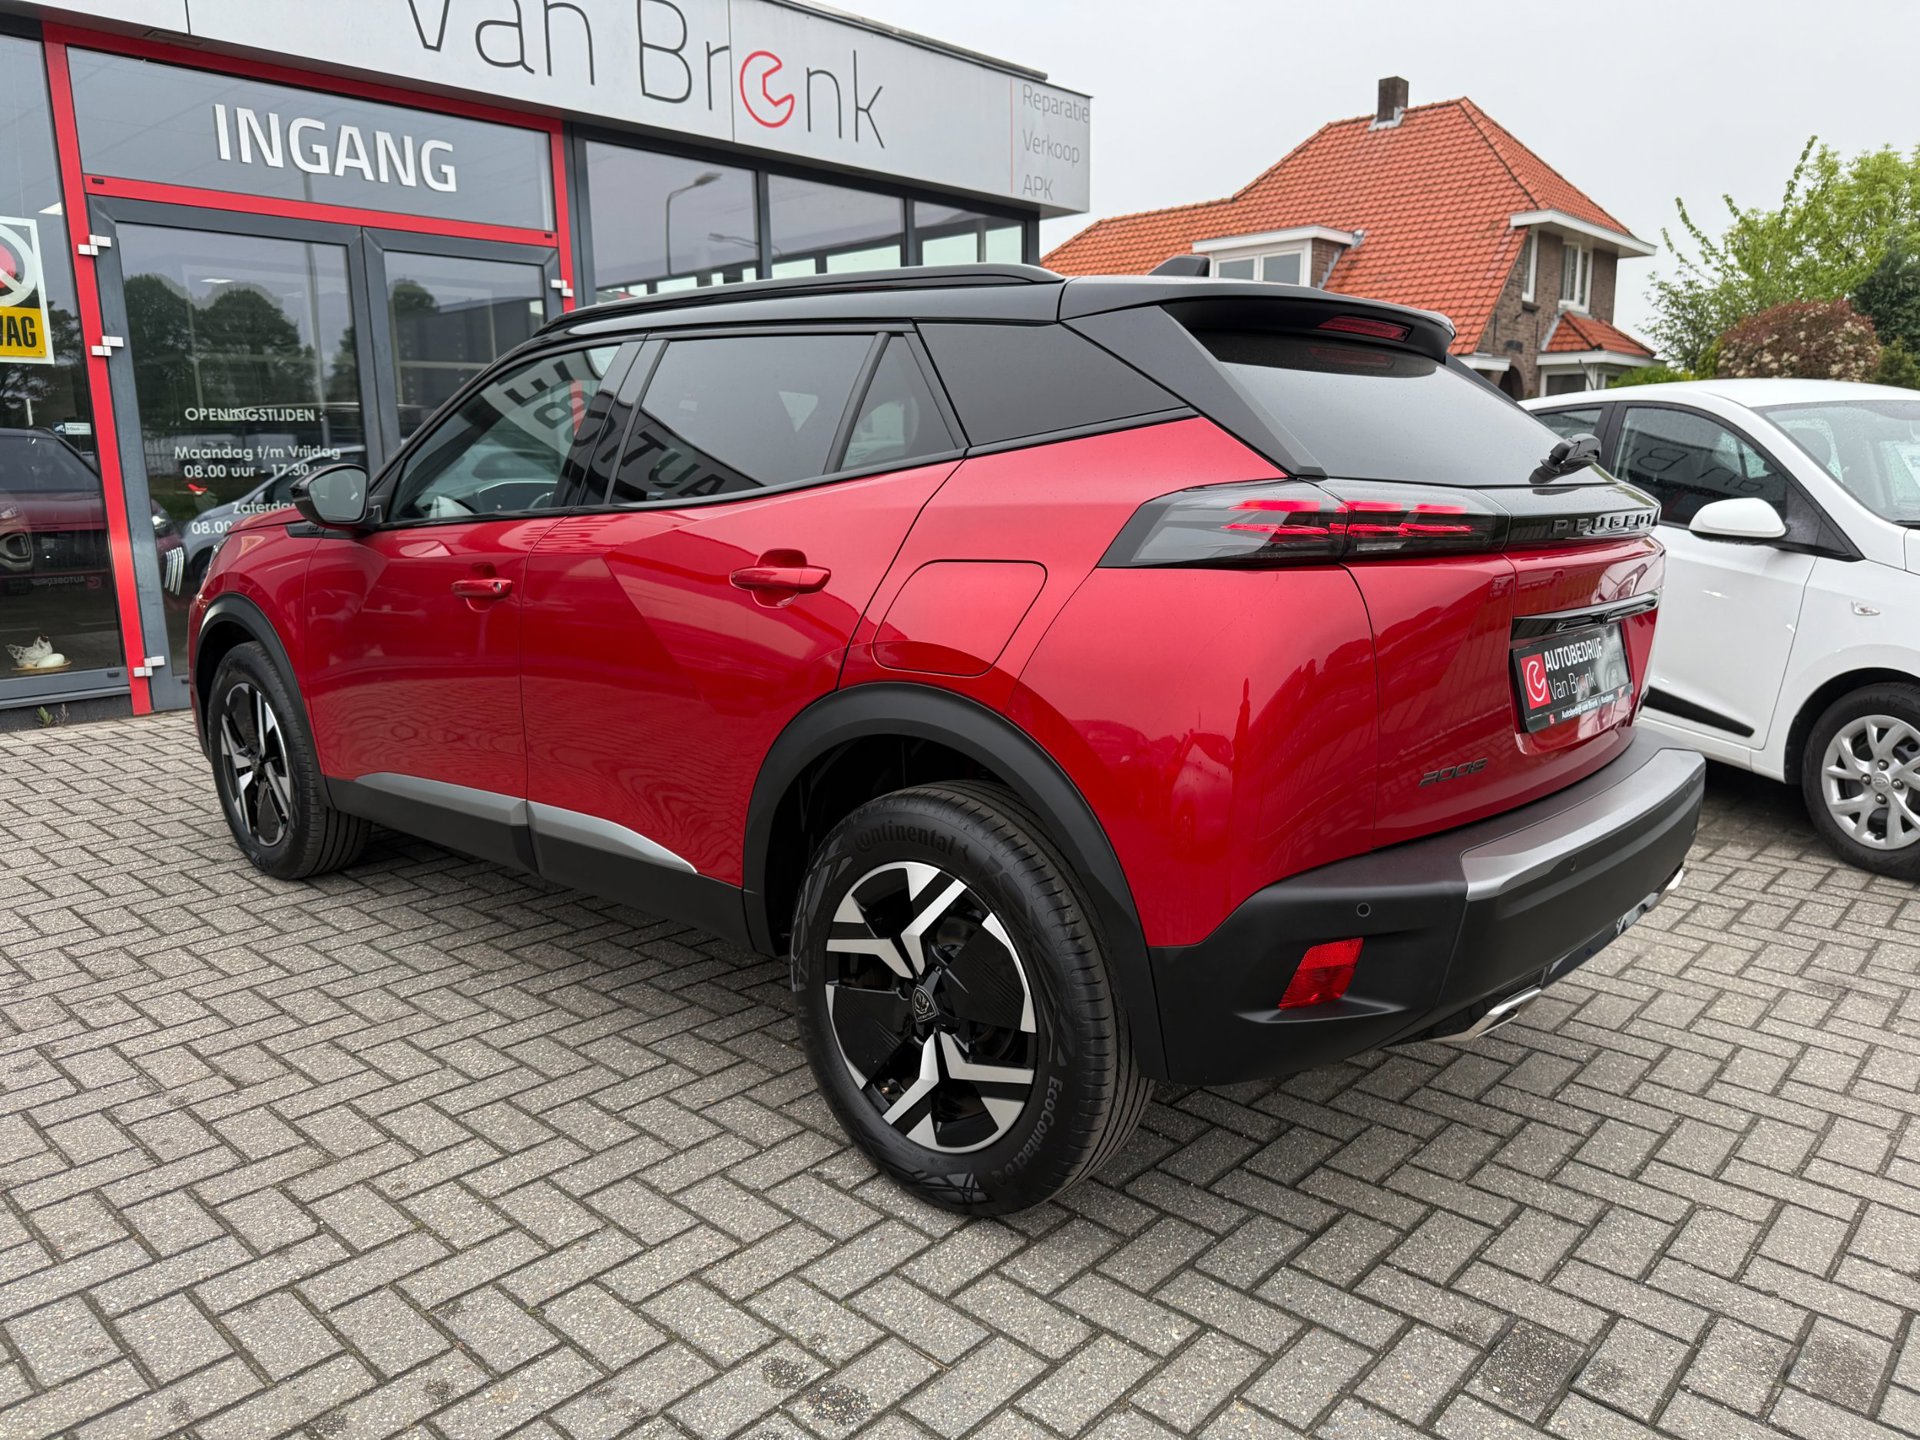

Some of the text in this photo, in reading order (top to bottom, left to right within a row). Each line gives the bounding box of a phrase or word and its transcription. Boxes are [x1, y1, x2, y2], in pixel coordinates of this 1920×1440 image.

[1022, 83, 1089, 124] Reparatie
[214, 103, 457, 193] INGANG
[1022, 128, 1081, 168] Verkoop
[1022, 173, 1053, 200] APK
[0, 314, 37, 348] AG
[184, 407, 315, 422] OPENINGSTIJDEN
[174, 445, 341, 461] Maandag t/m Vrijdag
[184, 465, 226, 478] 08.00
[231, 466, 255, 477] uur
[271, 463, 309, 476] 17.30
[232, 501, 296, 515] Zaterda
[1544, 637, 1602, 672] AUTOBEDRIJF
[1548, 677, 1570, 700] Van
[1419, 757, 1489, 787] 2008
[855, 820, 957, 857] Continental
